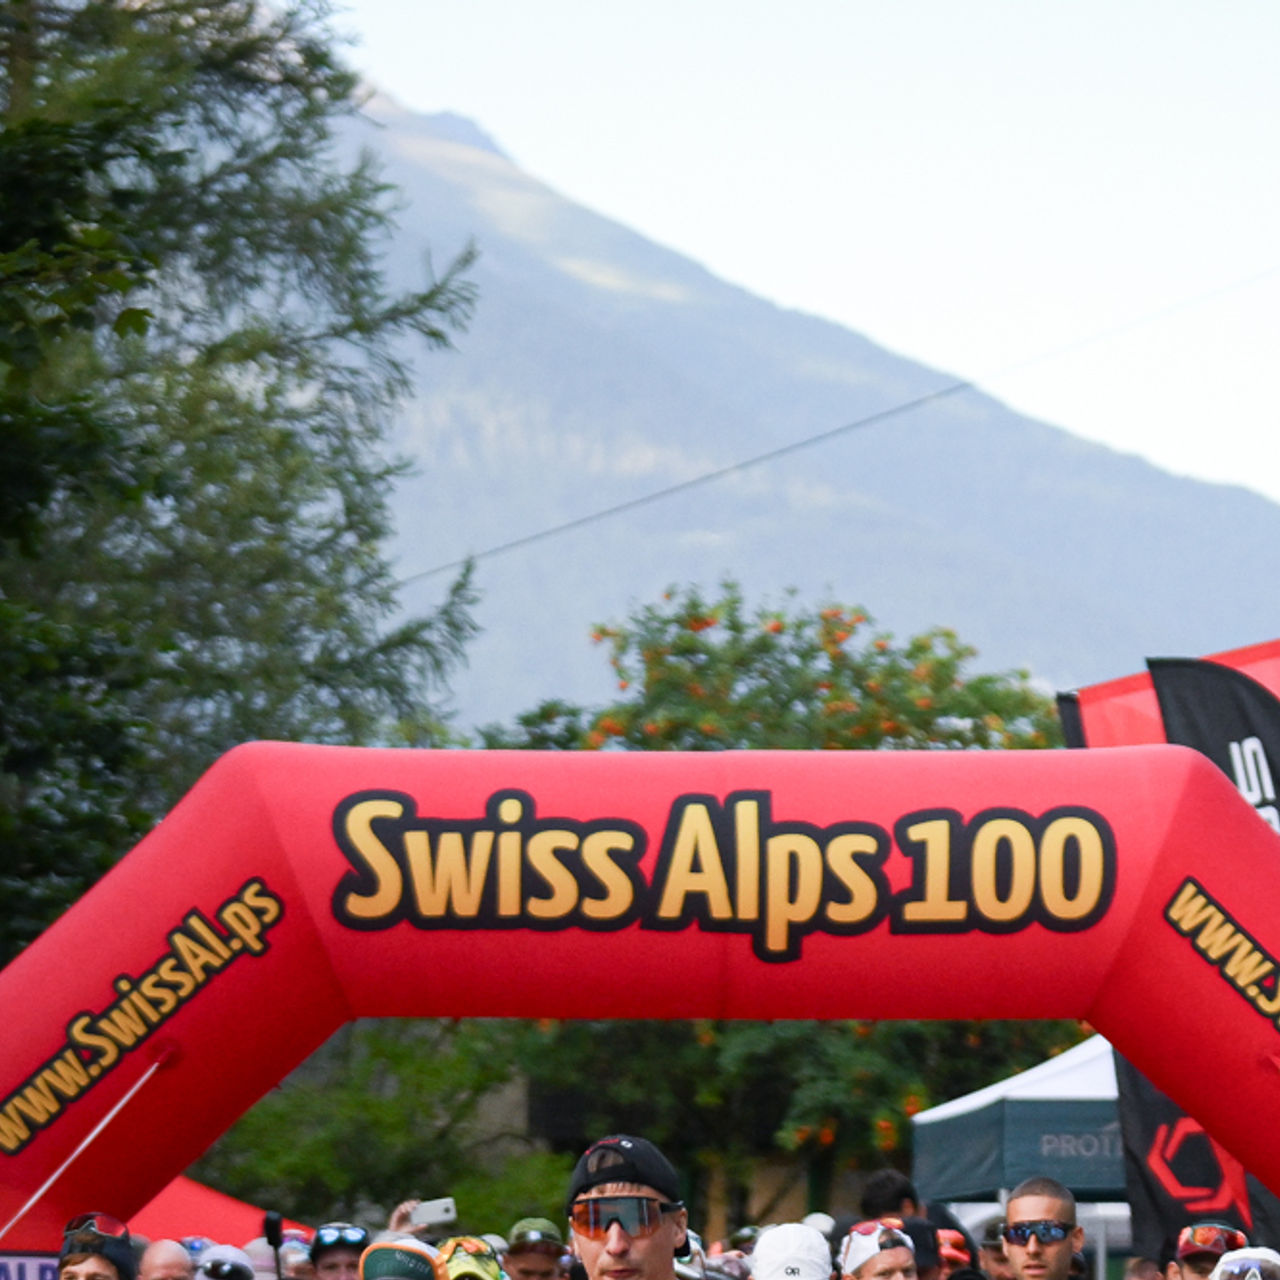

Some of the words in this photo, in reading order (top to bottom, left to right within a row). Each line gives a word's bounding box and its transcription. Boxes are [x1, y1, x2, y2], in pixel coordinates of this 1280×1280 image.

[340, 794, 638, 923] Swiss
[654, 796, 881, 955] Alps
[900, 814, 1106, 927] 100
